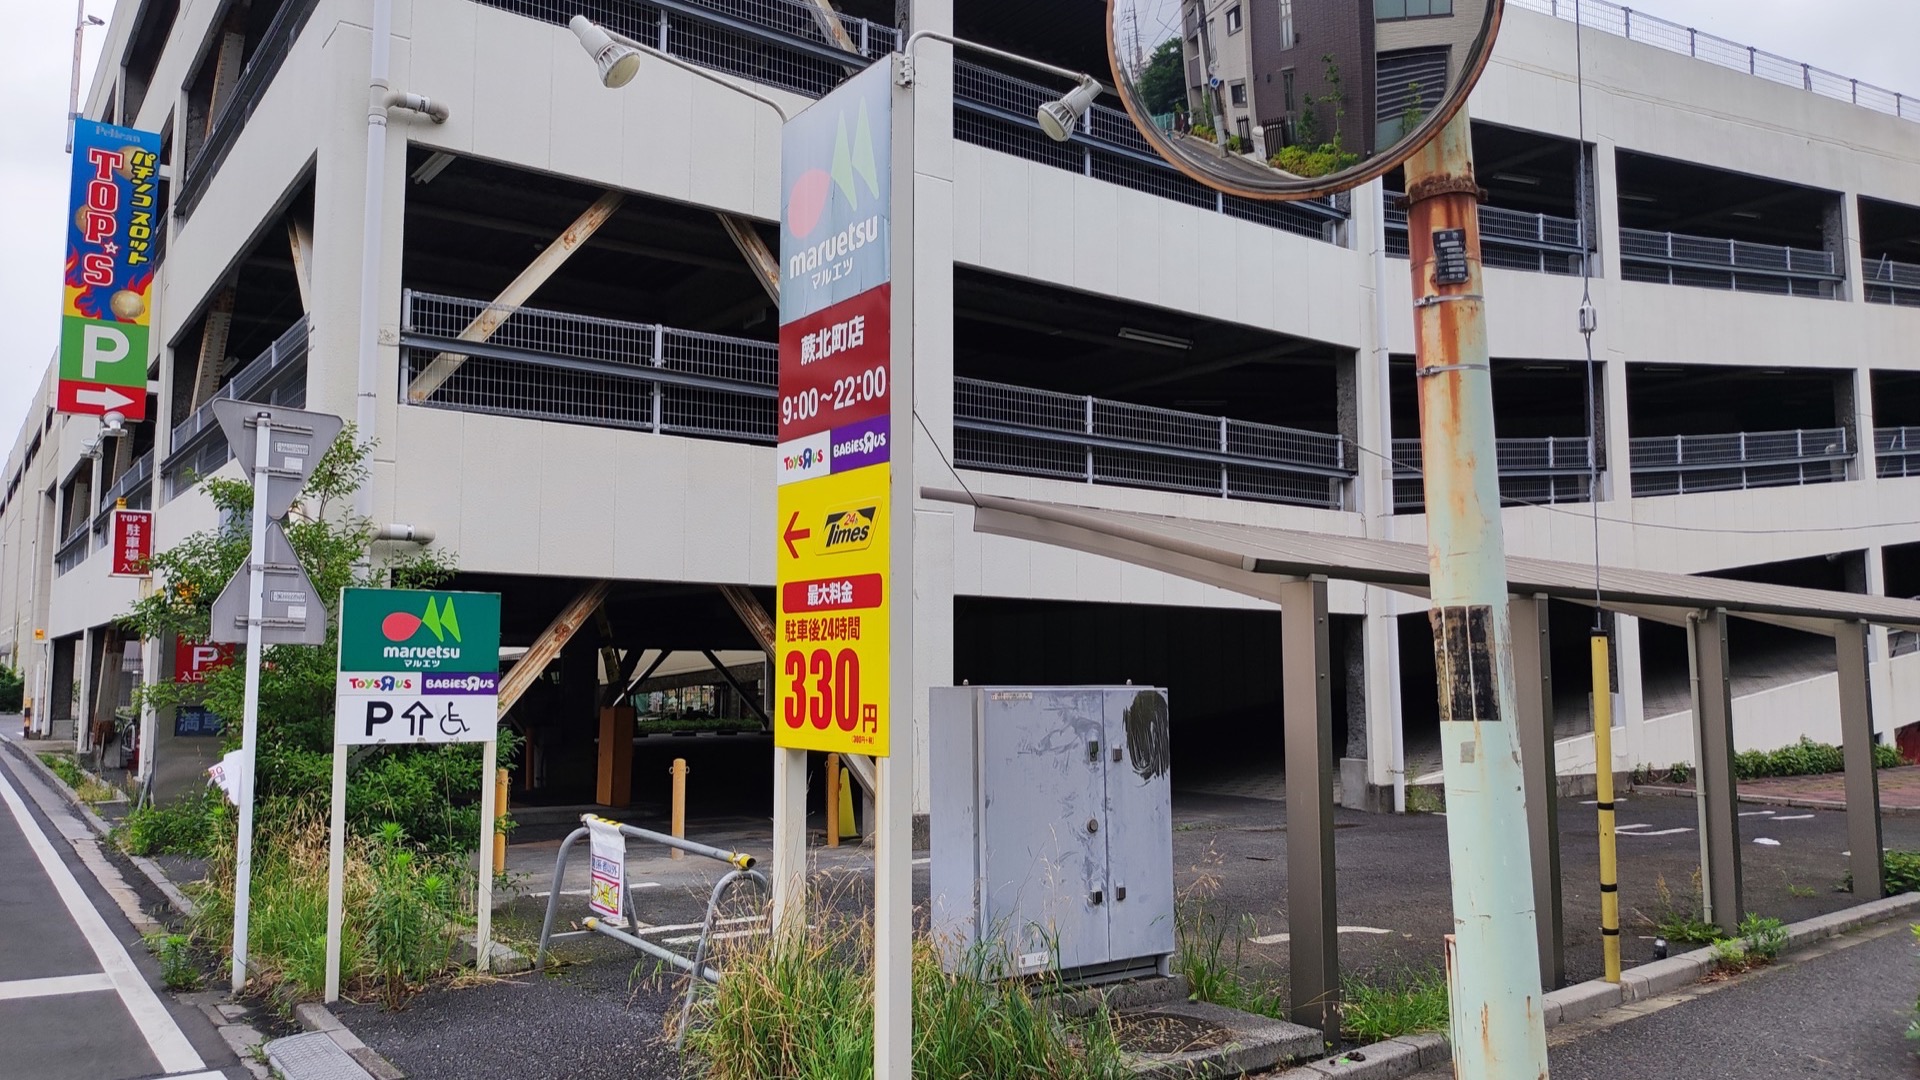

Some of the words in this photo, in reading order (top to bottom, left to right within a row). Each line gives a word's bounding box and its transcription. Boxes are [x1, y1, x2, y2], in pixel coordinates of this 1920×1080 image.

[789, 215, 878, 280] maruetsu
[811, 256, 854, 290] マルエツ
[81, 324, 130, 379] P
[800, 315, 865, 366] 蕨北町店
[120, 513, 148, 523] TOP'S
[824, 506, 876, 548] Times
[124, 523, 141, 561] 駐車場
[807, 580, 854, 606] 最大料金
[784, 616, 861, 642] 駐車後24時間
[383, 645, 460, 659] maruetsu
[403, 659, 441, 668] マルエツ
[365, 700, 394, 737] P
